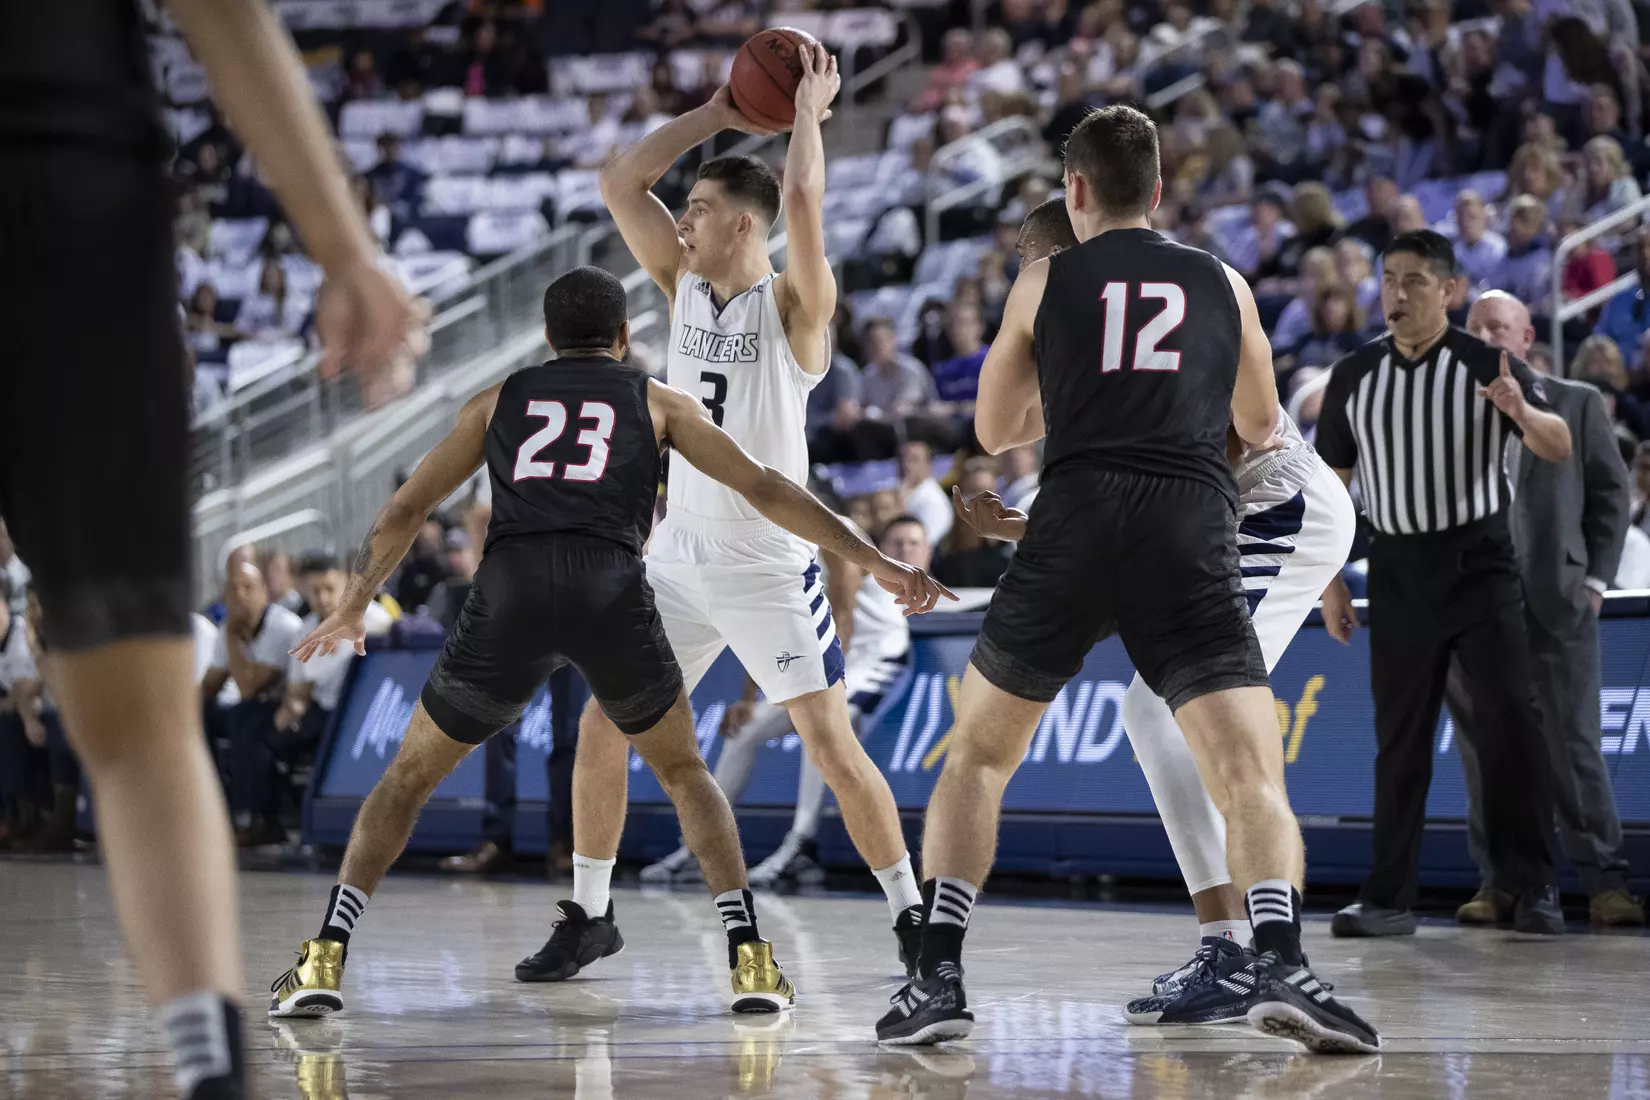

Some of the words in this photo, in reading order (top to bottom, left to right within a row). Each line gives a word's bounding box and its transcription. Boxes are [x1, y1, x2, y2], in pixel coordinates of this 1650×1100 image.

[679, 324, 758, 363] LANCERS
[1099, 280, 1187, 374] 12
[513, 399, 617, 483] 23
[700, 371, 728, 429] 3
[1022, 680, 1130, 763] ND
